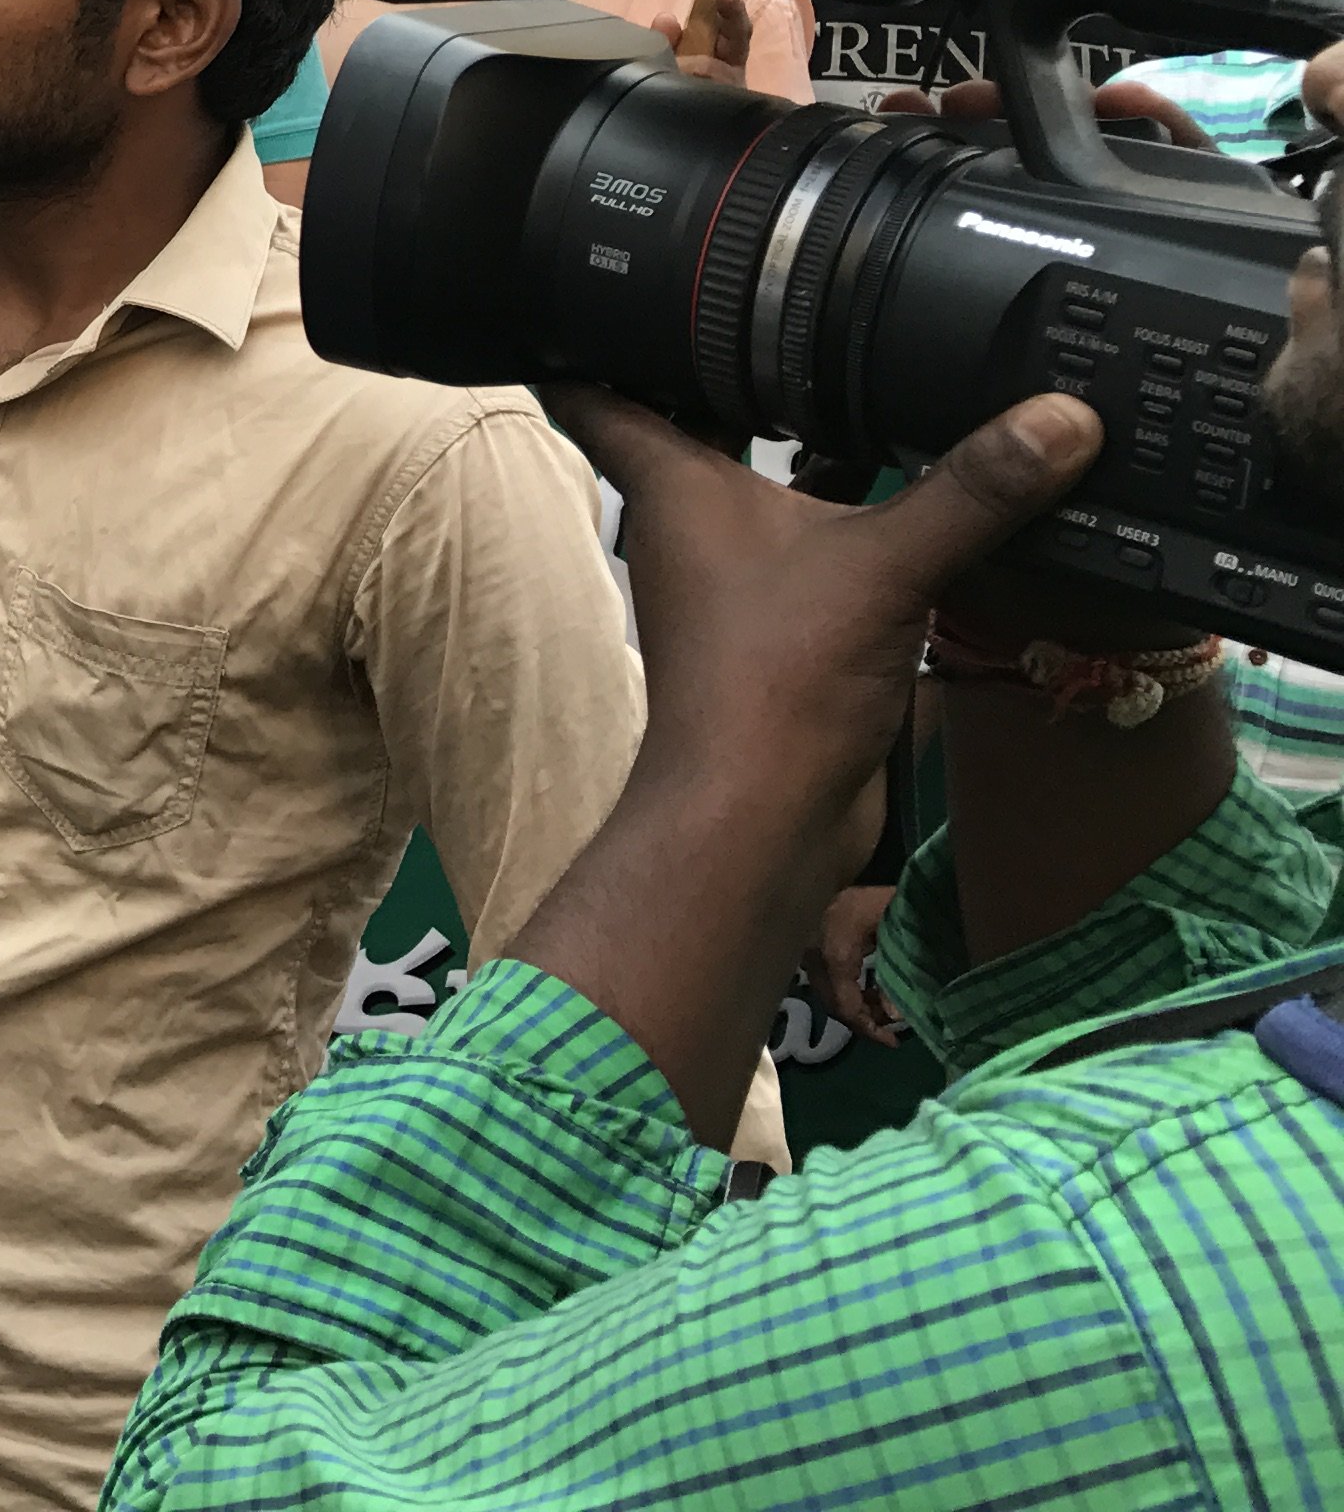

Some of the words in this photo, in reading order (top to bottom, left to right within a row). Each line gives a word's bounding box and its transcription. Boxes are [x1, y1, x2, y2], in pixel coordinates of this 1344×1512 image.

[589, 171, 668, 204] 3MOS
[590, 194, 628, 211] FULL
[628, 203, 655, 217] HD
[781, 196, 805, 231] ZOOM
[957, 211, 1096, 259] Panasonic
[1225, 324, 1269, 345] MENU
[1138, 380, 1182, 402] ZEBRA
[1192, 420, 1252, 445] COUNTER
